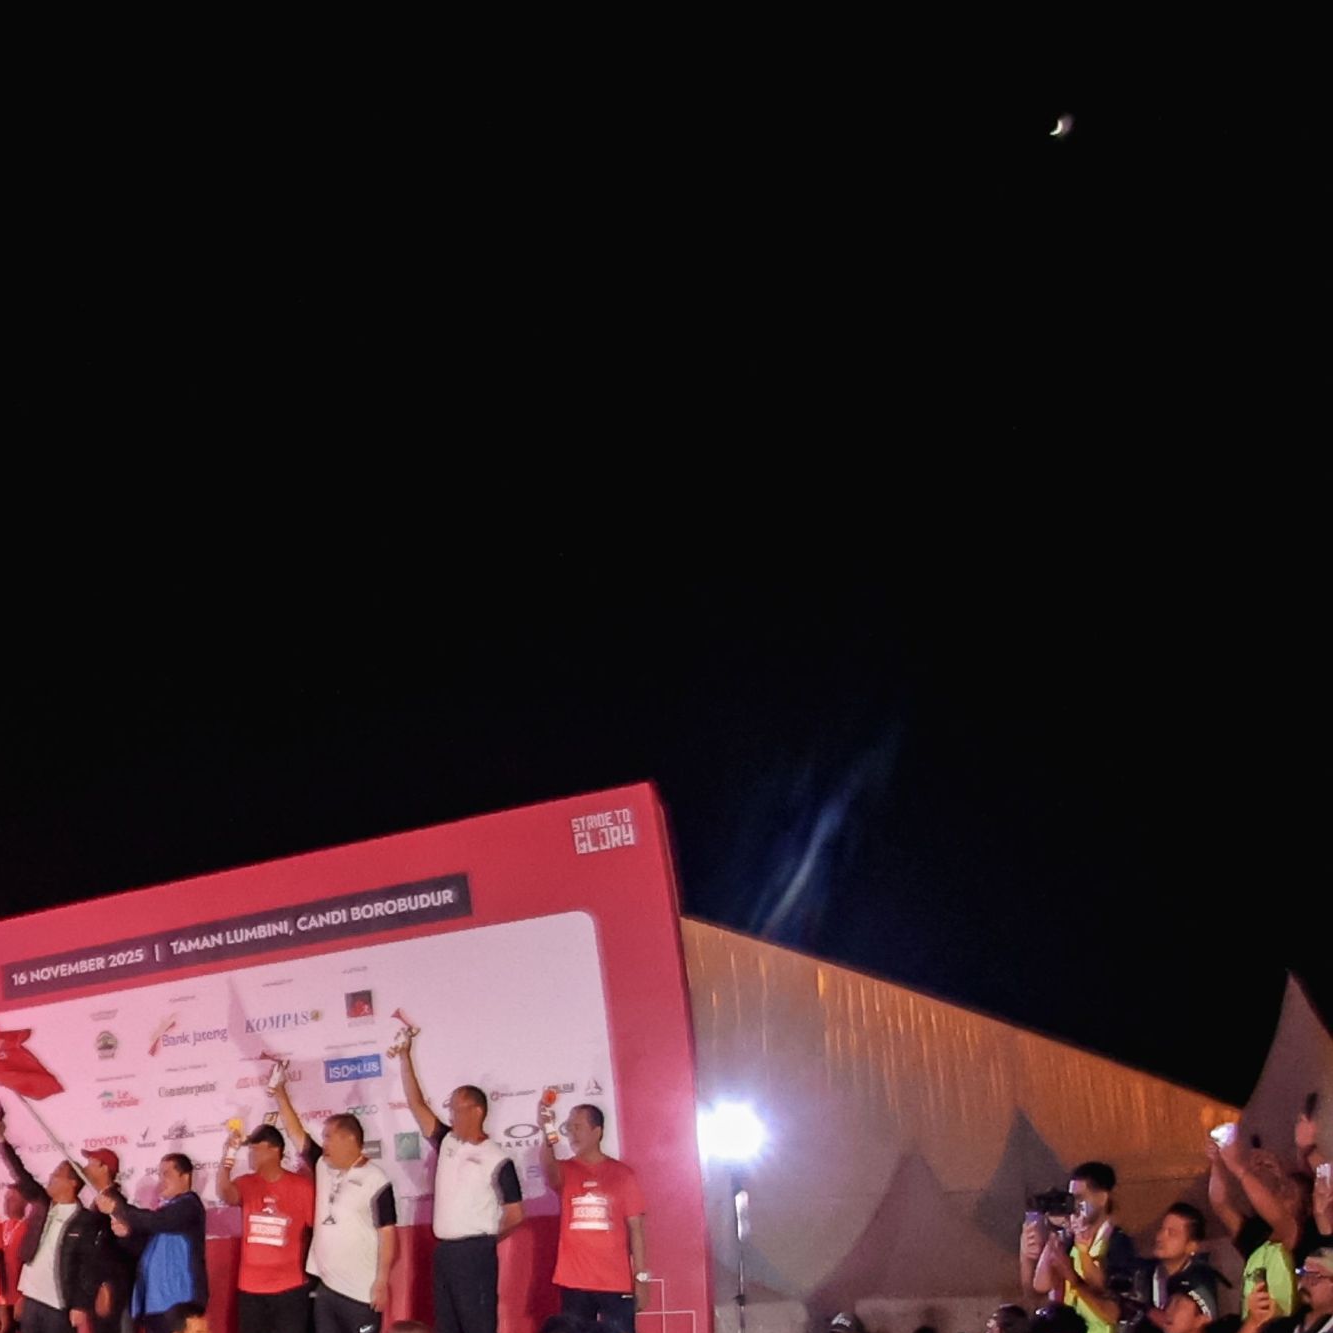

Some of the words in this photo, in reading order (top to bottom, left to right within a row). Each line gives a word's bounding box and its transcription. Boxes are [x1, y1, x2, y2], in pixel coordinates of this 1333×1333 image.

[571, 811, 614, 832] STRIDE
[614, 808, 631, 825] TO
[574, 823, 635, 855] GLORY
[12, 971, 28, 986] 16
[29, 956, 106, 984] NOVEMBER
[108, 948, 144, 970] 2025
[170, 931, 223, 956] TAMAN
[226, 919, 294, 946] LUMBINI,
[296, 908, 347, 933] CANDI
[351, 889, 454, 923] BOROBUDUR
[245, 1010, 309, 1034] KOMPAS
[162, 1033, 190, 1047] Bank
[83, 1135, 128, 1149] TOYOTA
